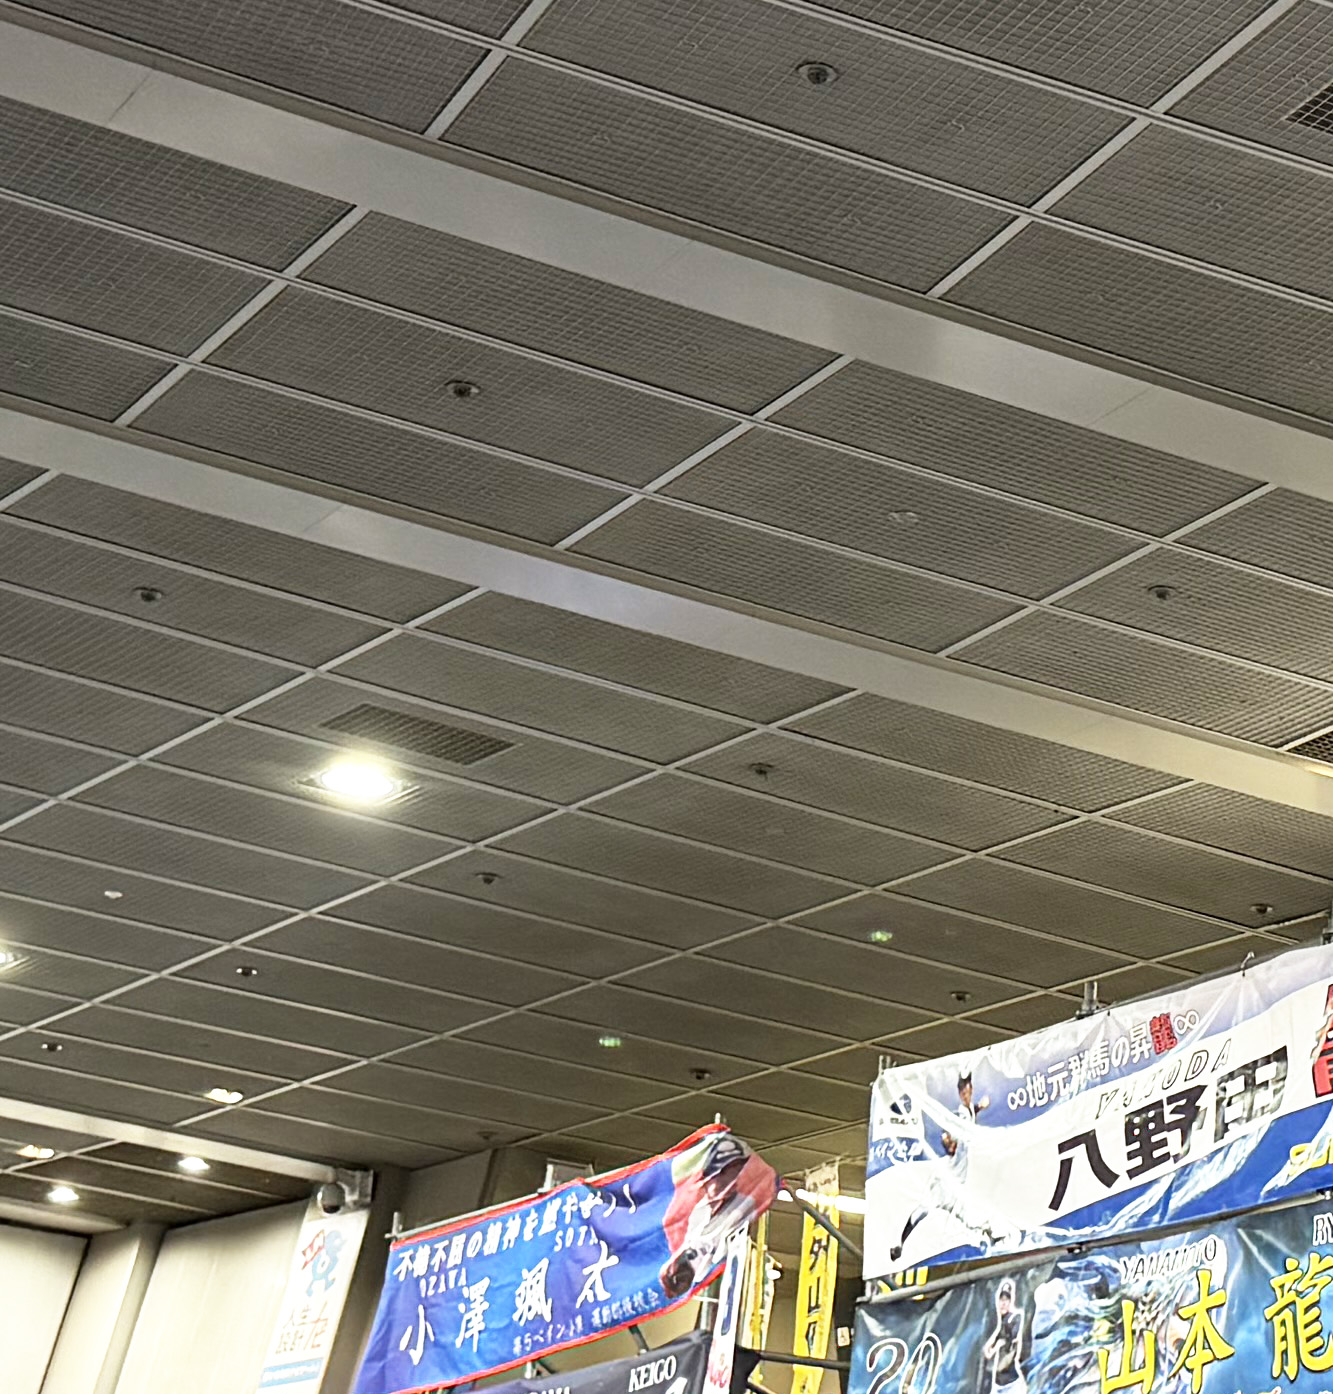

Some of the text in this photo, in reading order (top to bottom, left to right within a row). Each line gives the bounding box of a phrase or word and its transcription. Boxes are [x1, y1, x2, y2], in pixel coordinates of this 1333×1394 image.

[1048, 1045, 1289, 1211] 八野田
[628, 1356, 678, 1393] KEIGO
